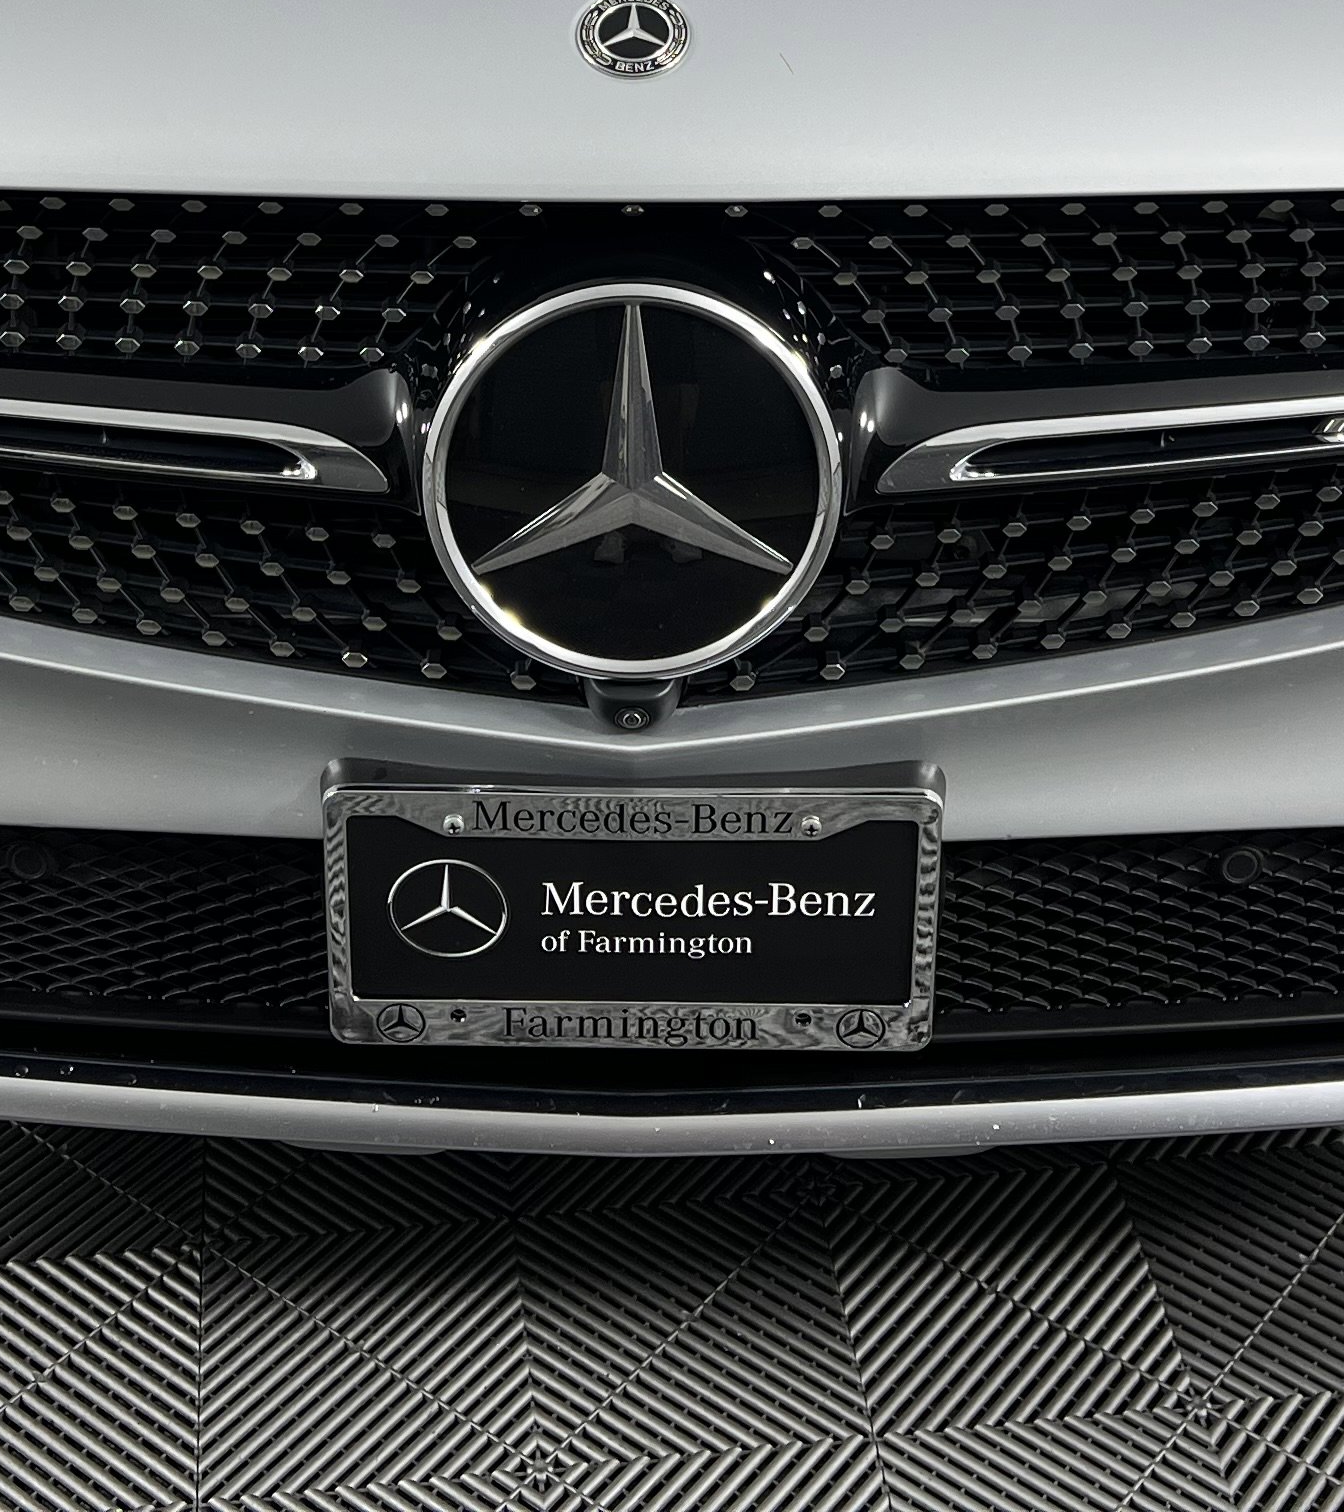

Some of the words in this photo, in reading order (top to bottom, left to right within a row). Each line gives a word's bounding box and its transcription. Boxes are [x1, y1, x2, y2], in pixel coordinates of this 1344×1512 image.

[615, 61, 654, 72] BENZ
[472, 799, 794, 835] Mercedes-Benz
[541, 882, 875, 917] Mercedes-Benz
[541, 930, 571, 953] of
[577, 930, 752, 959] Farmington
[502, 1007, 760, 1048] Farmington
